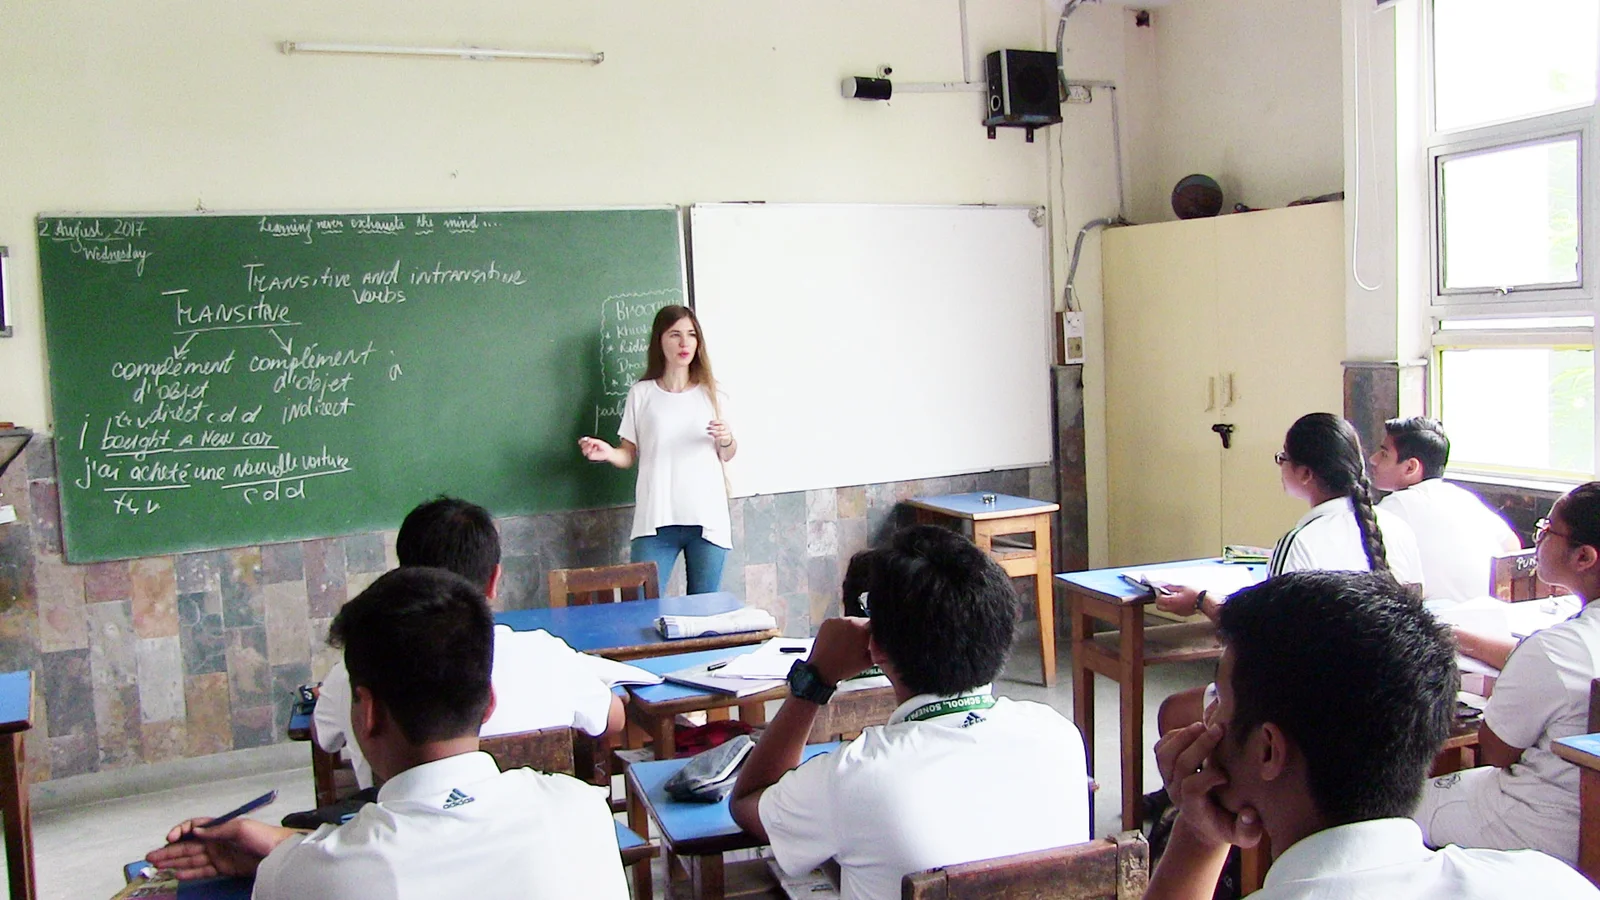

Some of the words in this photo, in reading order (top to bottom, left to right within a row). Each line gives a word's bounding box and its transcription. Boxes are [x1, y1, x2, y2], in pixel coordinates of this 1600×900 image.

[39, 220, 51, 236] 2
[113, 219, 147, 237] 2017
[259, 216, 313, 244] Learning
[316, 220, 344, 231] never
[416, 214, 434, 228] the
[83, 243, 153, 277] Wednesday
[101, 418, 170, 461] bought
[242, 431, 273, 446] car
[130, 461, 191, 484] acheté
[194, 466, 226, 480] une
[943, 696, 981, 709] SCHOOL,
